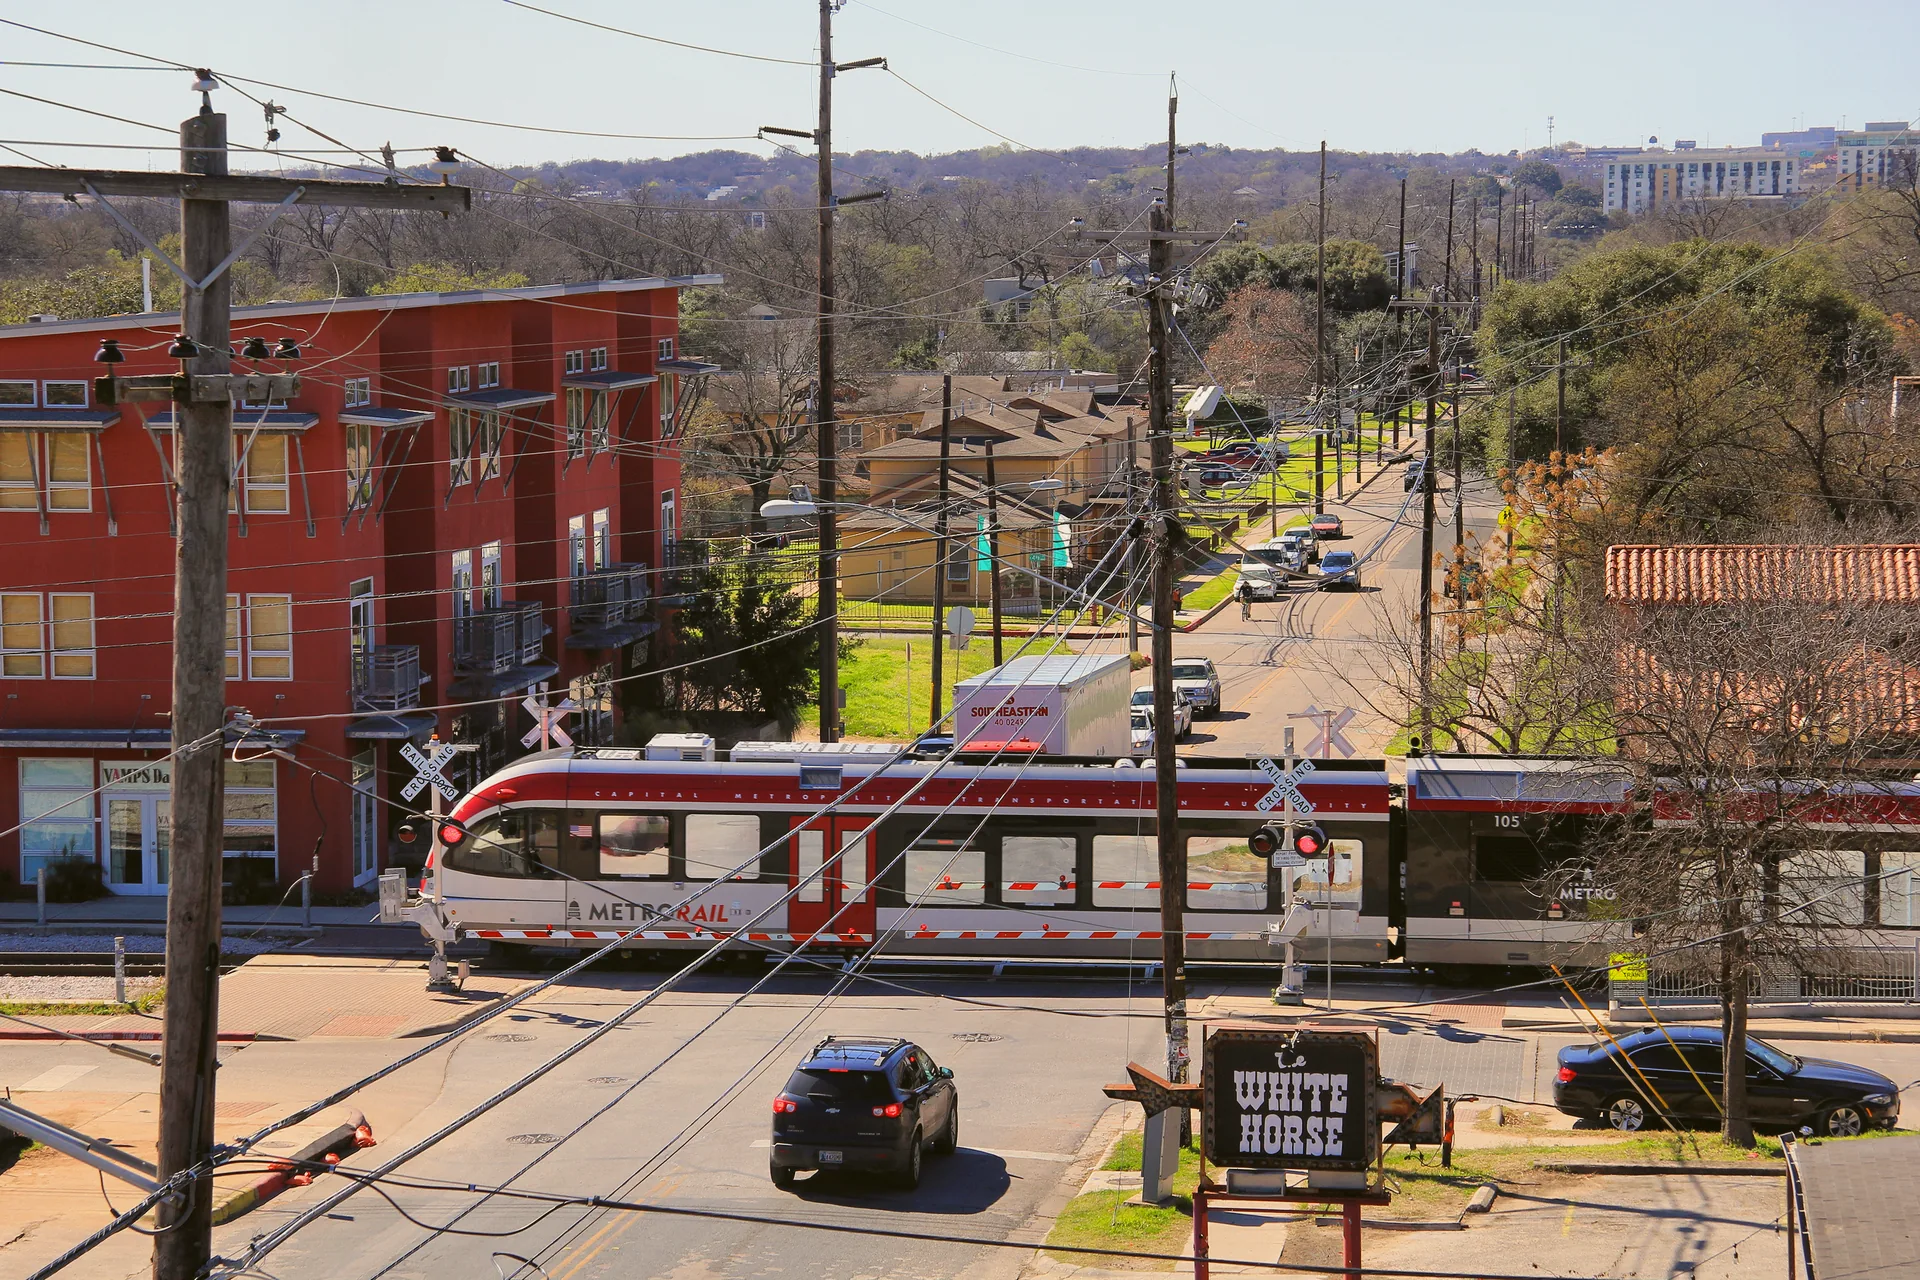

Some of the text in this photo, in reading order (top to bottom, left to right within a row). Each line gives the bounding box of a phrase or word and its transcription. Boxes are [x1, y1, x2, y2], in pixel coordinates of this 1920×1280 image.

[994, 718, 1024, 726] 40 0249
[103, 768, 170, 784] VAMPS Da
[402, 746, 455, 798] RAIL ROAD
[404, 746, 454, 798] CROSSING
[1258, 762, 1312, 812] CROSSING
[1259, 758, 1311, 815] RAIL ROAD
[594, 791, 1368, 809] CAPITAL METROPLITN TRANSPORTATIN AUHRITY
[1494, 815, 1521, 828] 105
[1559, 888, 1618, 900] METRO
[589, 903, 729, 923] METRORAIL
[1274, 1051, 1307, 1069] Te
[1233, 1070, 1349, 1114] WHITE
[1239, 1114, 1344, 1156] HORSE
